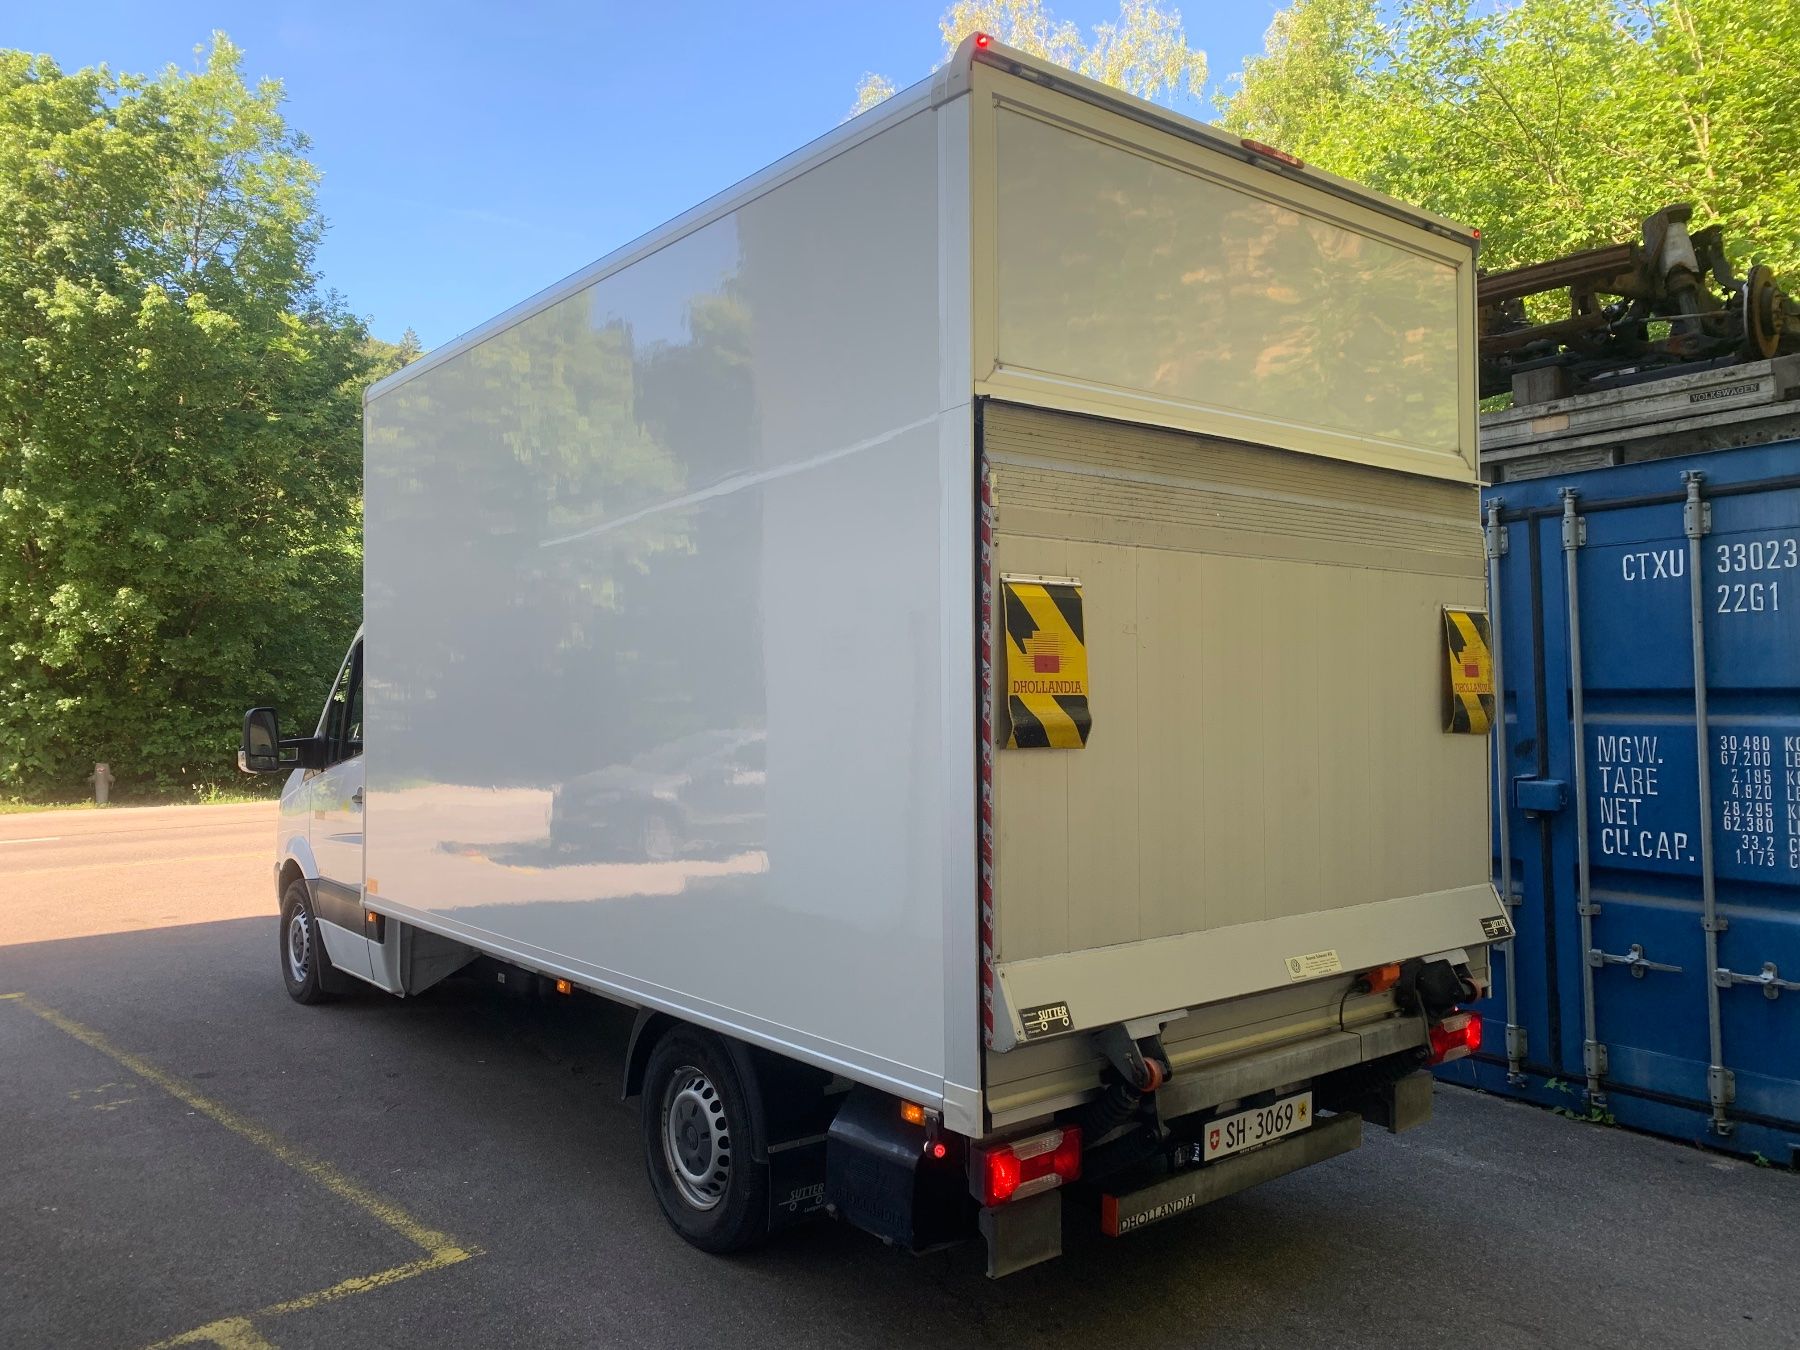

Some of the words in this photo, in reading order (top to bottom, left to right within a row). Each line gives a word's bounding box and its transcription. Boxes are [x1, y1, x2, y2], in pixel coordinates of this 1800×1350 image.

[1692, 384, 1758, 402] VOLKSWAGEN
[1622, 549, 1684, 581] CTXU
[1717, 539, 1798, 573] 33023
[1717, 582, 1779, 613] 22G1
[1013, 680, 1083, 694] DHOLLANDIA
[1597, 735, 1663, 764] MGW.
[1720, 735, 1770, 751] 30.480
[1721, 751, 1771, 767] 67.200
[1599, 766, 1658, 795] TARE
[1731, 768, 1772, 785] 2.185
[1732, 783, 1772, 800] 4.820
[1600, 796, 1642, 826] NET
[1723, 801, 1773, 818] 28.295
[1724, 816, 1774, 834] 62.380
[1741, 834, 1775, 852] 33.2
[1736, 849, 1775, 867] 1.173
[1037, 1005, 1068, 1021] SUTTER
[789, 1182, 825, 1201] SUTTER
[1120, 1195, 1195, 1232] DHOLLANDIA
